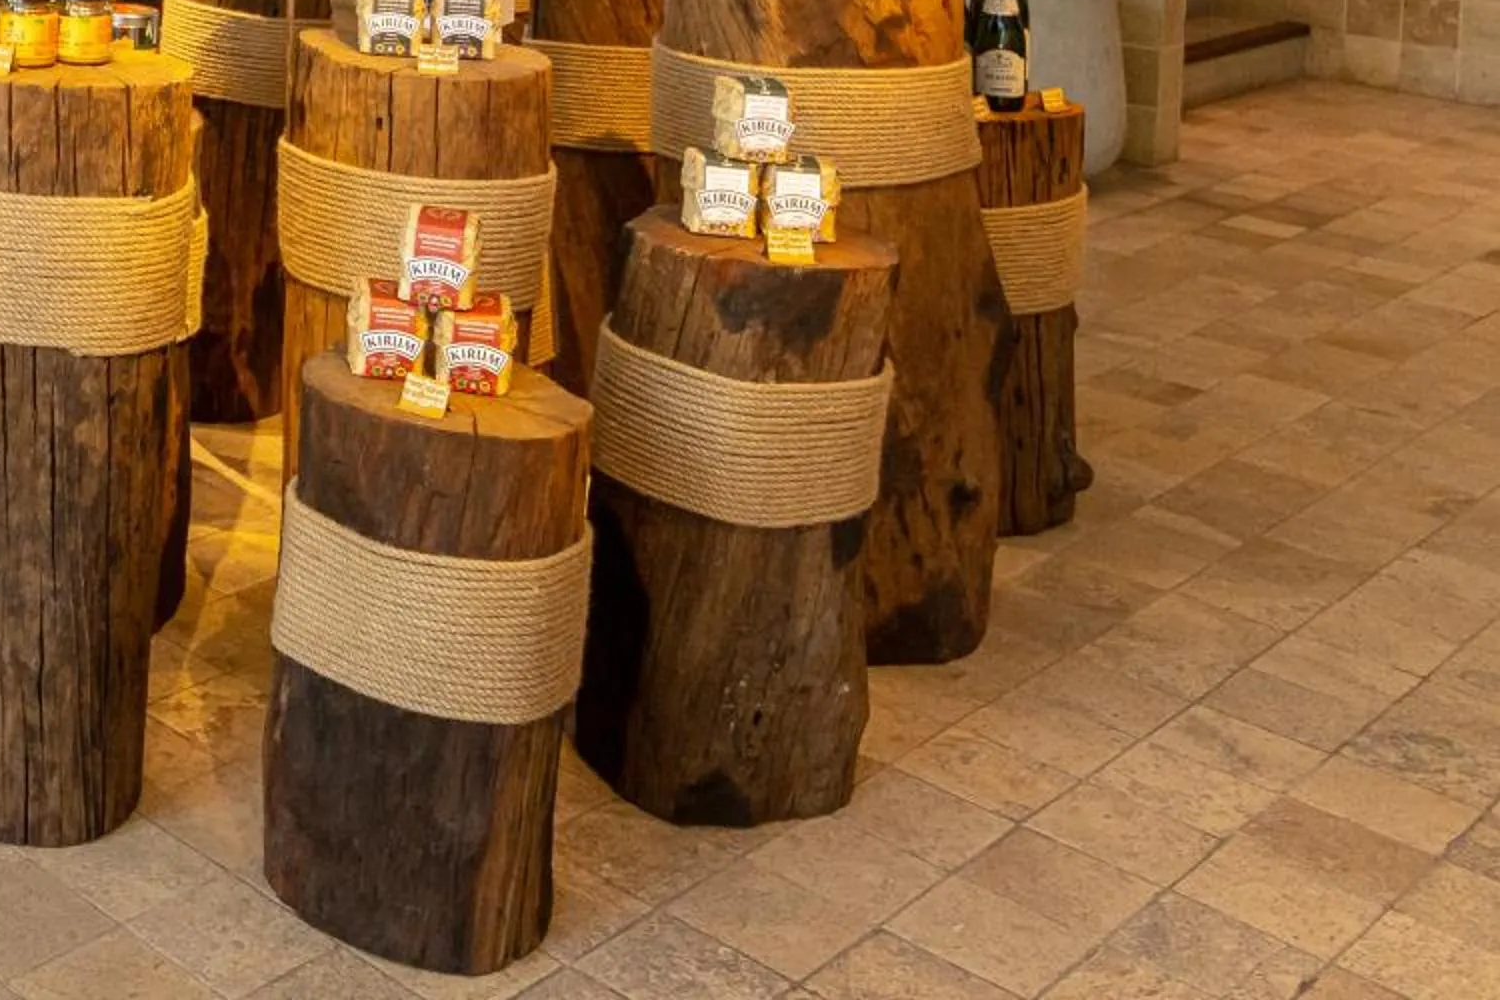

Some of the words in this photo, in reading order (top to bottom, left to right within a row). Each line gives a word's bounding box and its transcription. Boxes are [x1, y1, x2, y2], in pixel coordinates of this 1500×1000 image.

[411, 261, 464, 283] KIRUM
[367, 334, 418, 354] KIRUM
[451, 347, 501, 368] KIRUM
